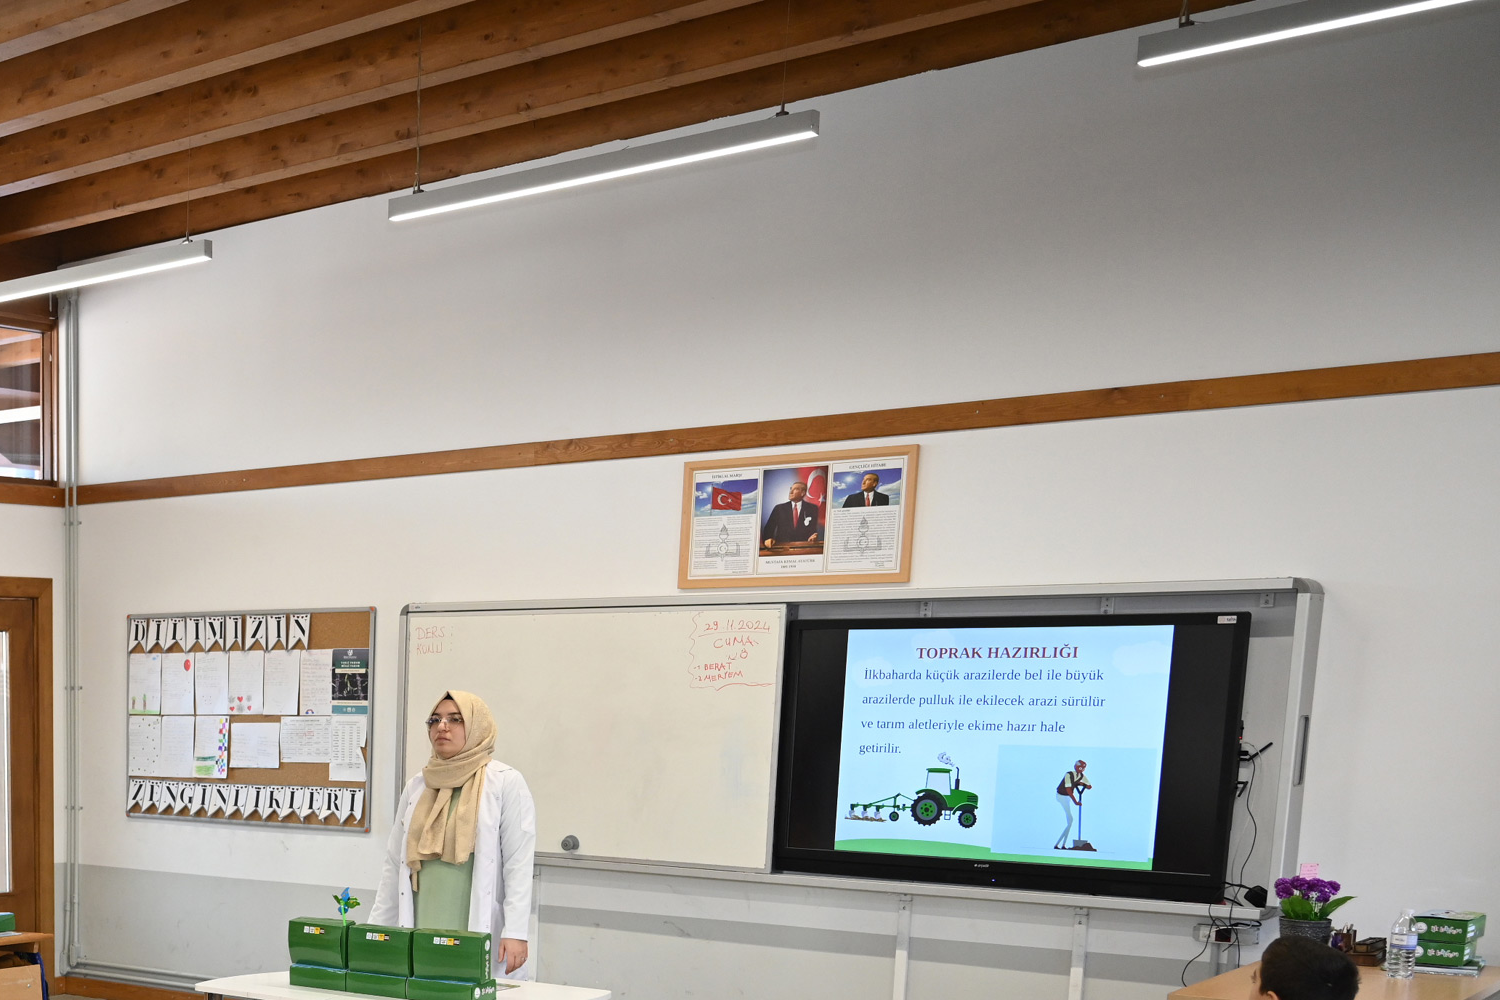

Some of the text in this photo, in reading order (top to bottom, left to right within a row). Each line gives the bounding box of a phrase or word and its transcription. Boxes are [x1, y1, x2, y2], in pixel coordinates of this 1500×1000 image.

[415, 625, 445, 640] DERS
[713, 634, 759, 648] CUMA
[916, 643, 1079, 659] TOPRAK HAZIRLIĞI
[704, 662, 732, 671] BERAT
[864, 667, 1104, 684] İlkbaharda küçük arazilerde bel ile büyük
[862, 693, 1106, 708] arazilerde pulluk ile ekilecek arazi sürülür
[861, 719, 1066, 733] ve tarım aletleriyle ekime hazır hale
[858, 743, 901, 756] getirilir.
